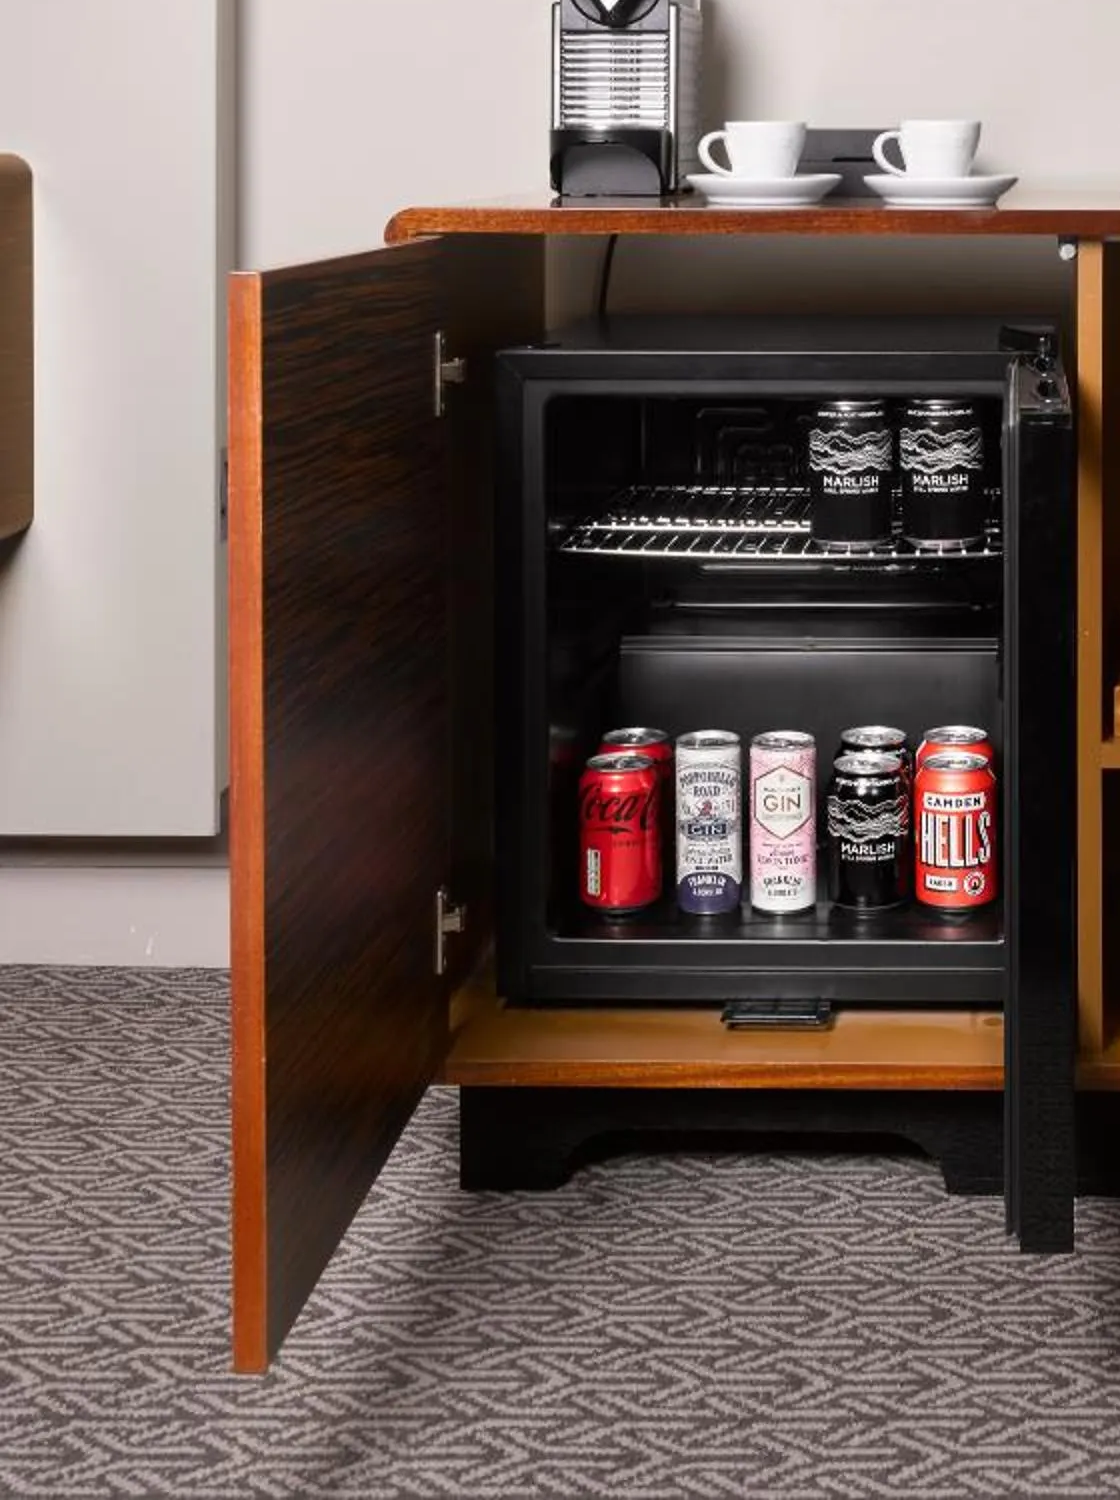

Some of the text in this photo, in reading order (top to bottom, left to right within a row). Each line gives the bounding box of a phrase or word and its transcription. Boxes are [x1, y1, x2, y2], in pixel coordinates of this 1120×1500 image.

[823, 475, 879, 487] MARLISH
[913, 474, 969, 487] MARLISH
[763, 794, 801, 812] GIN
[926, 796, 981, 808] CAMDEN
[921, 811, 991, 867] HELLS
[841, 842, 895, 855] MARLISH
